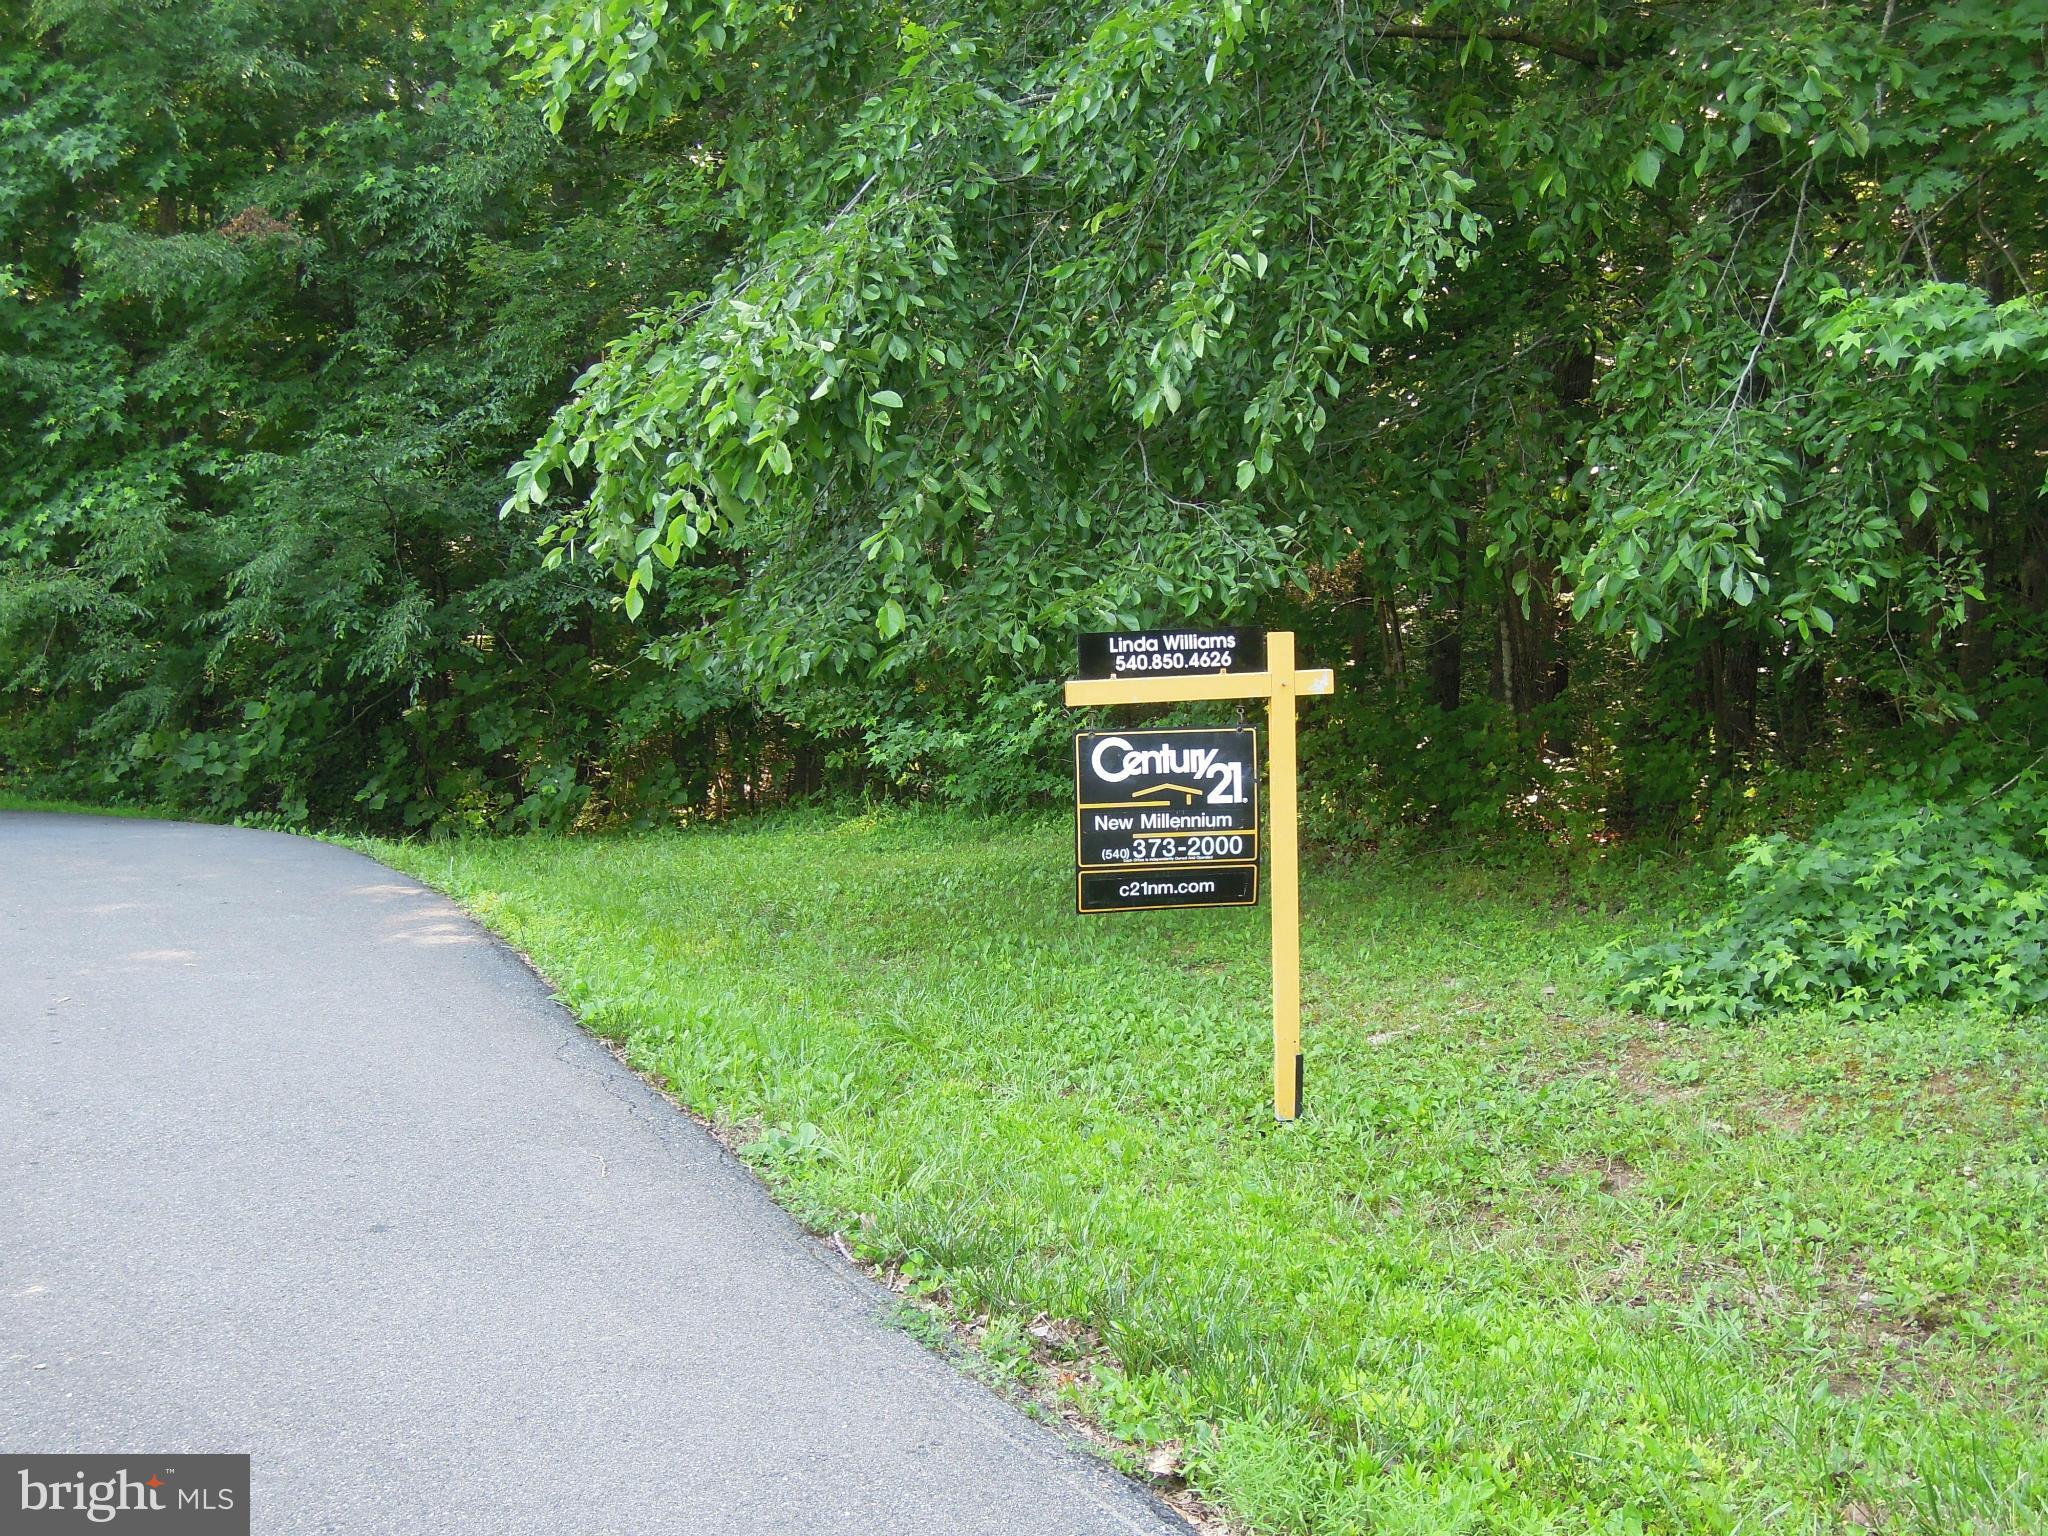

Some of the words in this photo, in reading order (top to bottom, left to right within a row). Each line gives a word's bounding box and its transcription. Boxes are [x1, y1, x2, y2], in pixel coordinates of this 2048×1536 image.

[1110, 636, 1158, 653] Linda
[1163, 632, 1236, 650] Williams
[1116, 652, 1231, 671] 540.850.4626
[1092, 737, 1219, 782] Century
[1207, 762, 1243, 804] 21
[1095, 816, 1133, 831] New
[1141, 813, 1232, 829] Millennium
[1102, 848, 1130, 860] (540)
[1133, 837, 1242, 858] 373-2000
[1119, 881, 1215, 897] c21nm.com
